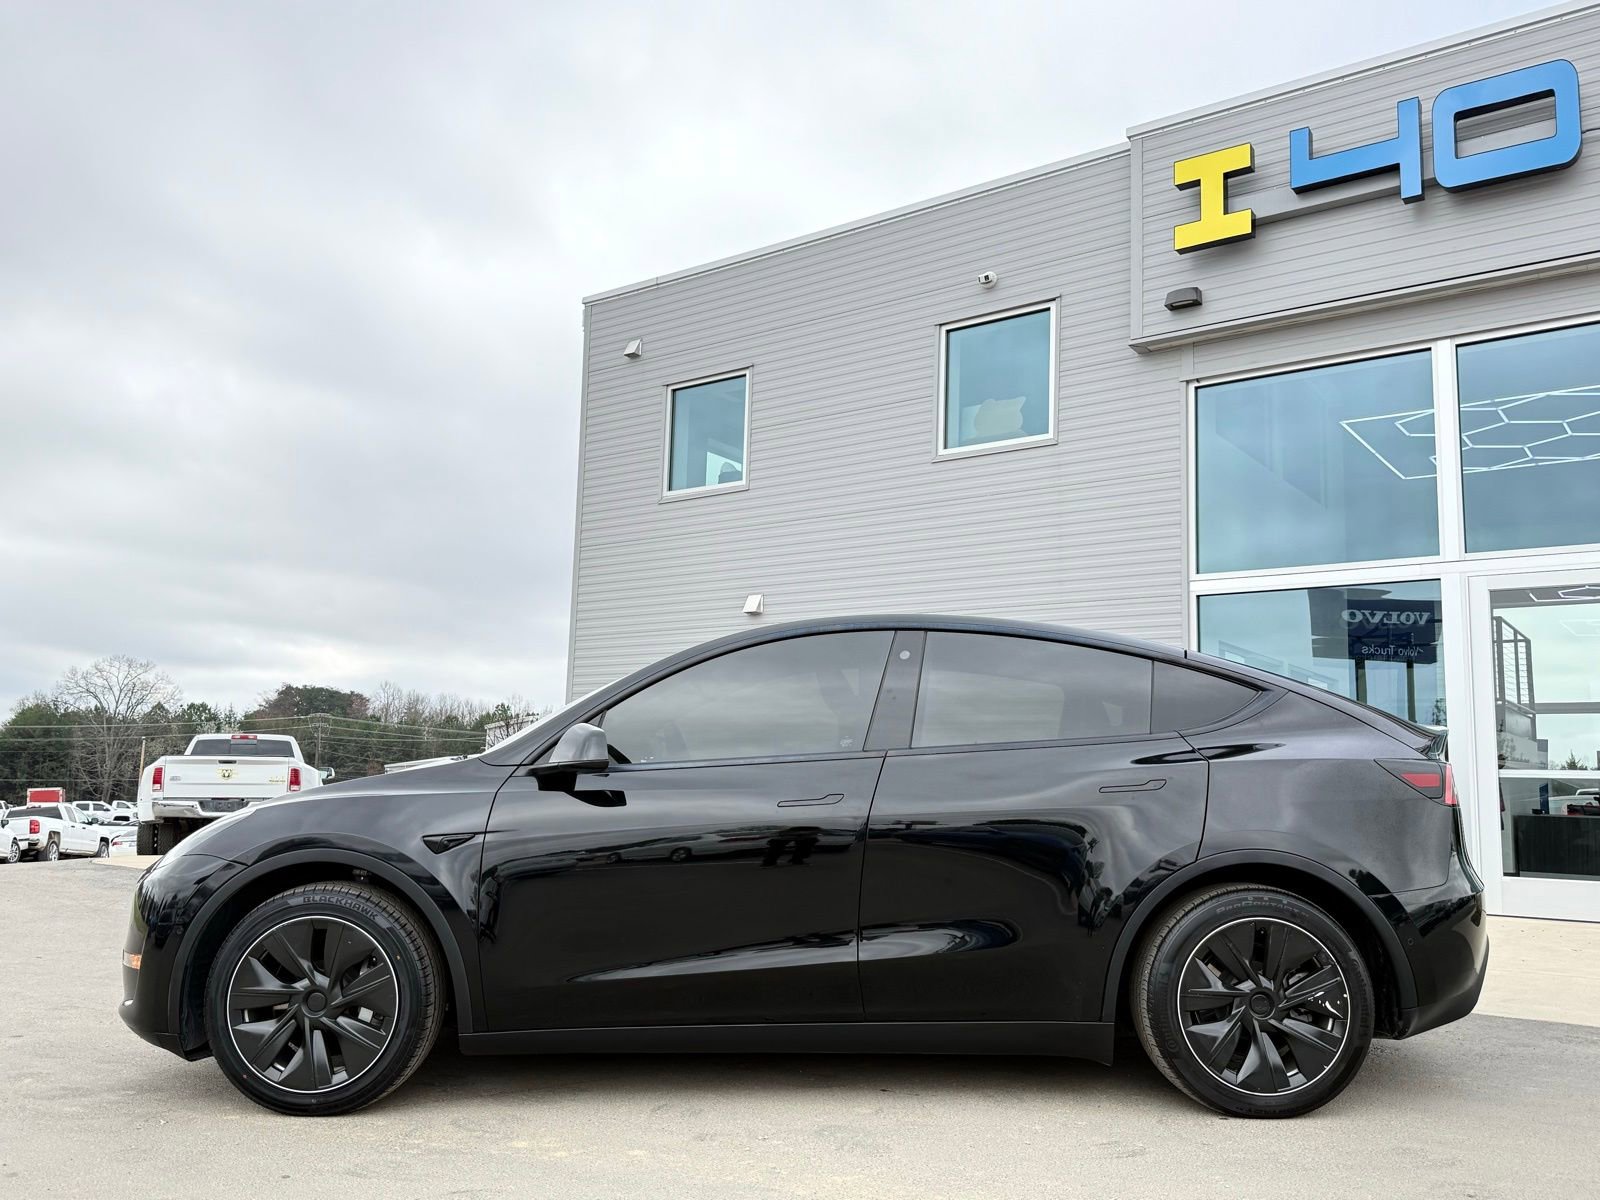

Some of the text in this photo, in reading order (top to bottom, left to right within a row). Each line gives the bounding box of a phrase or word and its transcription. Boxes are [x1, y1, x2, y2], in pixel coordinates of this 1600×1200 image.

[1174, 59, 1581, 254] I 40
[303, 895, 378, 920] BLACKHAWK
